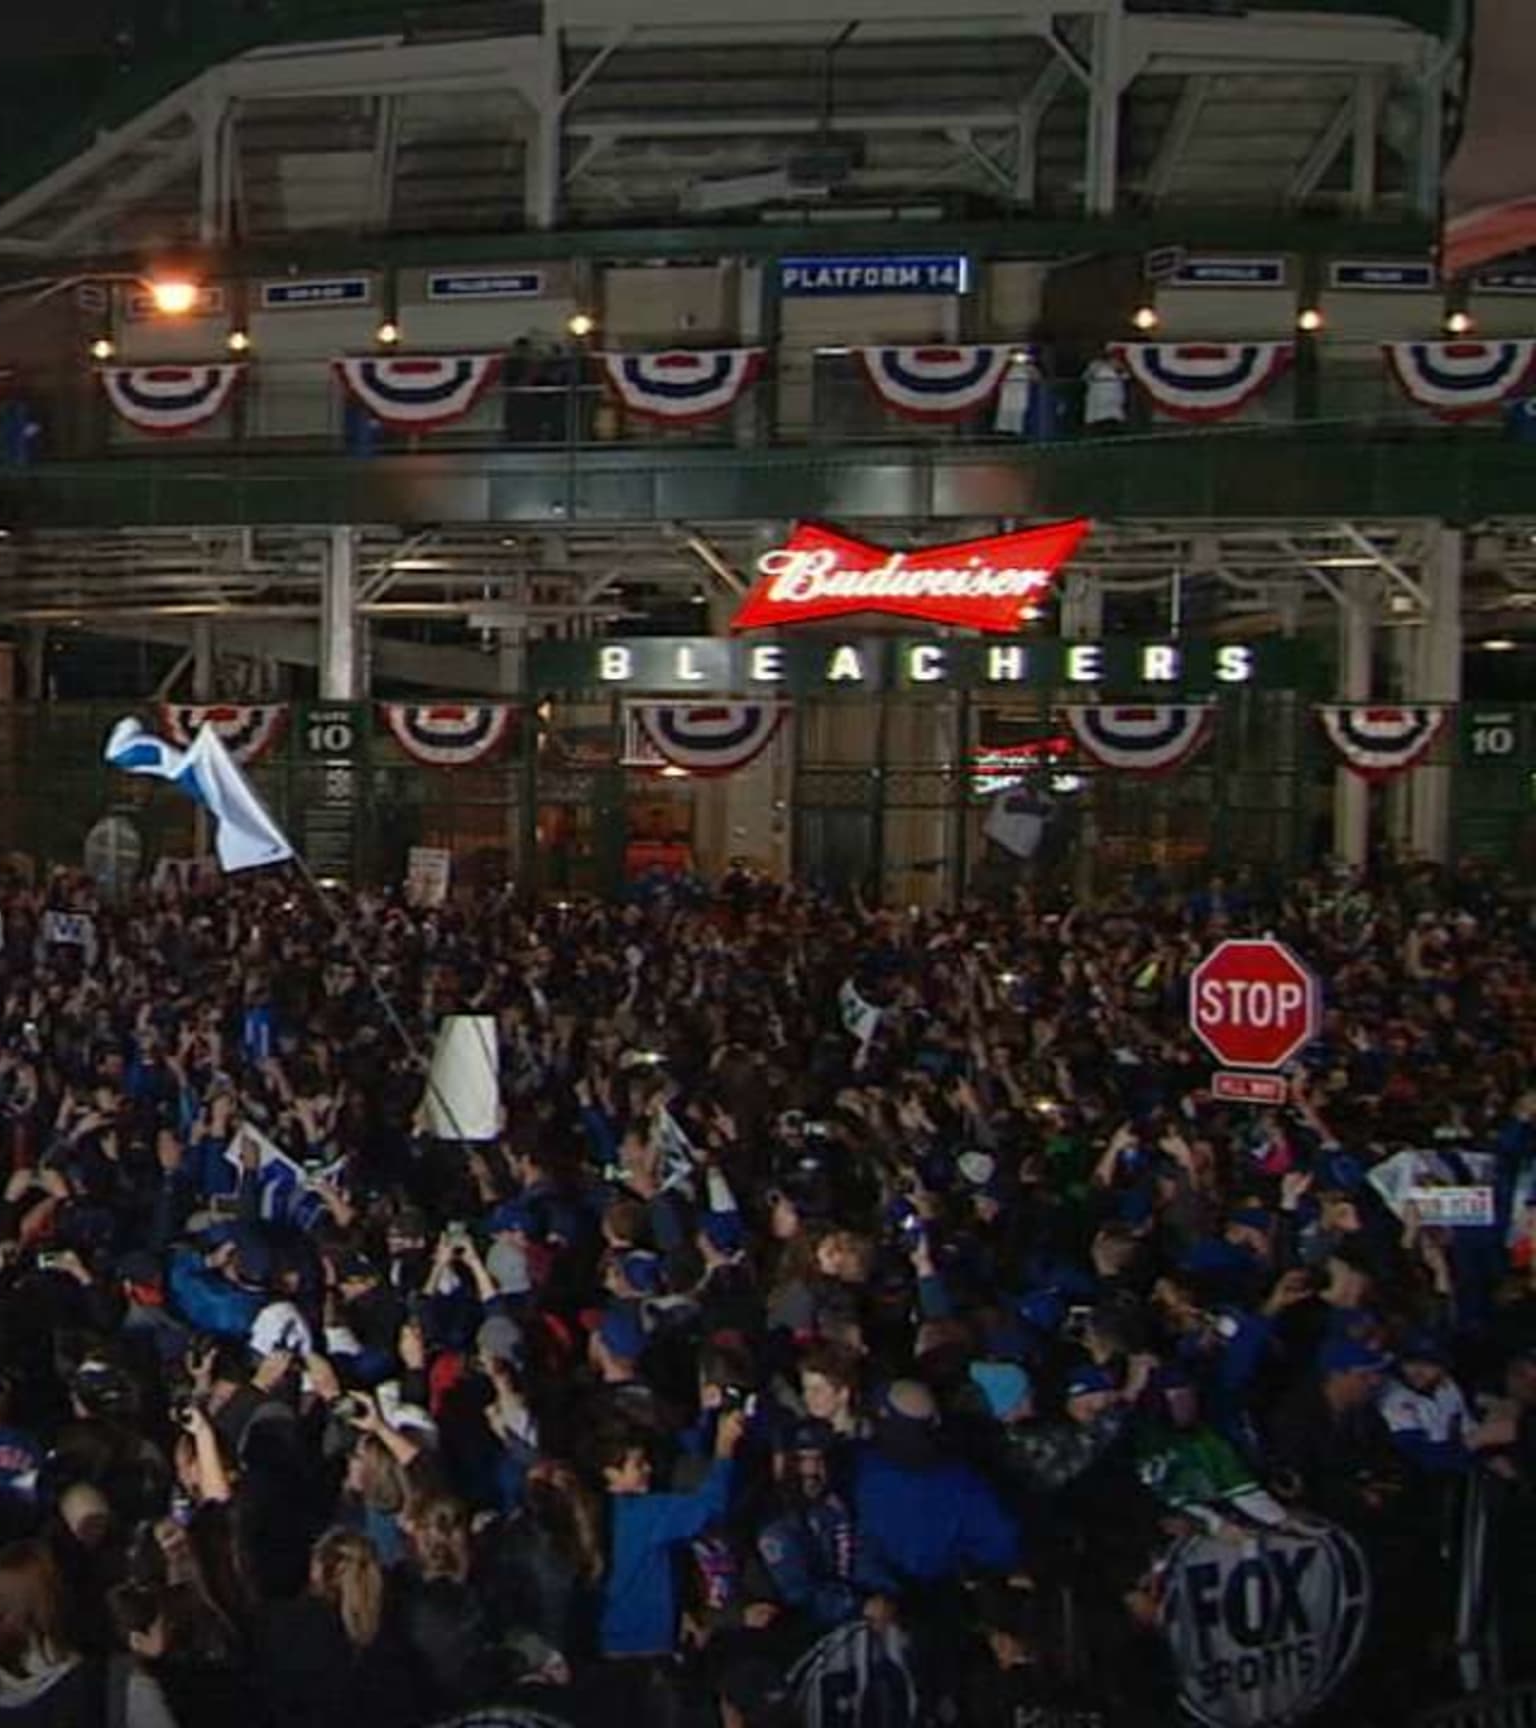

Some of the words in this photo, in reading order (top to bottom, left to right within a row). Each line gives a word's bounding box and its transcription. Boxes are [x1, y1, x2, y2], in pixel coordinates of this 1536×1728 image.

[783, 266, 918, 289] PLATFORM
[927, 265, 956, 285] 14
[758, 549, 1052, 602] Budweiser
[599, 646, 1252, 681] BLEACHERS
[309, 723, 352, 752] 10
[1473, 727, 1514, 755] 10
[1199, 979, 1303, 1029] STOP
[1185, 1545, 1318, 1664] FOX
